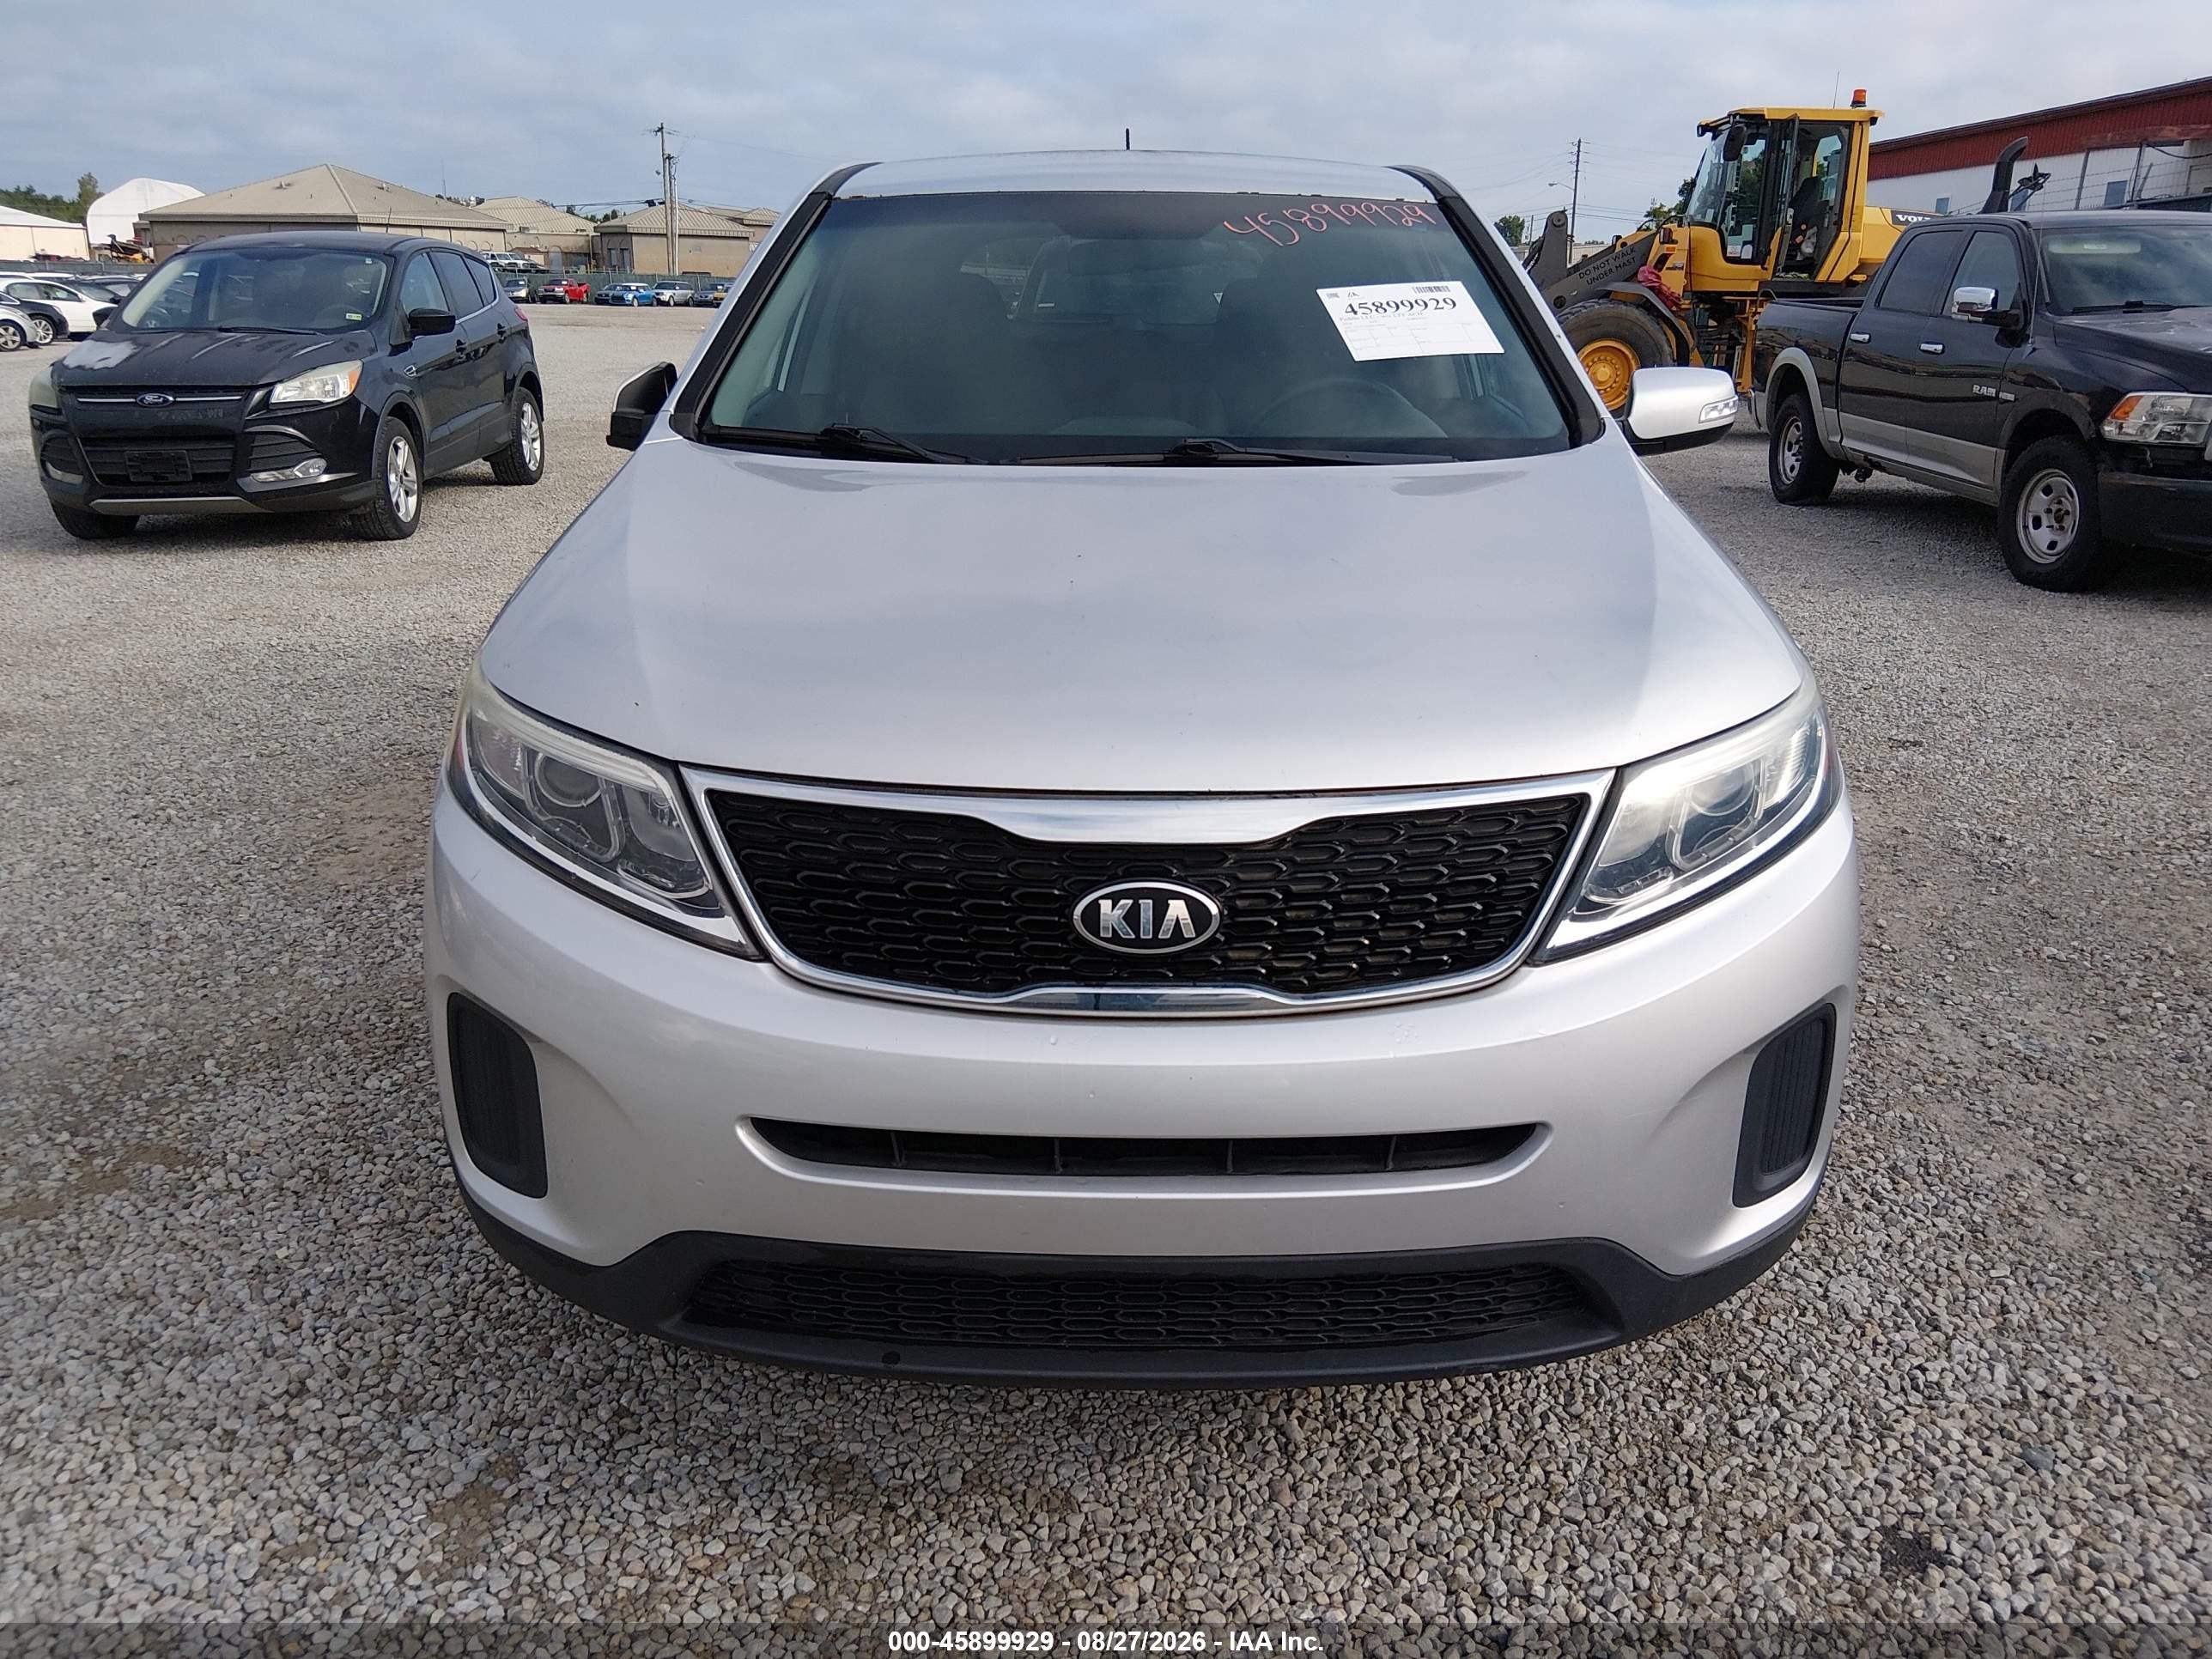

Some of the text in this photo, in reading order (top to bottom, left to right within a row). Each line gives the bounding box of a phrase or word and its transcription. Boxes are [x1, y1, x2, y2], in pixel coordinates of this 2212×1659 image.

[1224, 202, 1436, 247] 45899929
[1578, 246, 1635, 279] DO NOT WALK
[1586, 256, 1636, 285] UNDER MAST
[1345, 297, 1457, 316] 45899929
[1972, 384, 1996, 398] RAM
[1098, 898, 1196, 939] KIA
